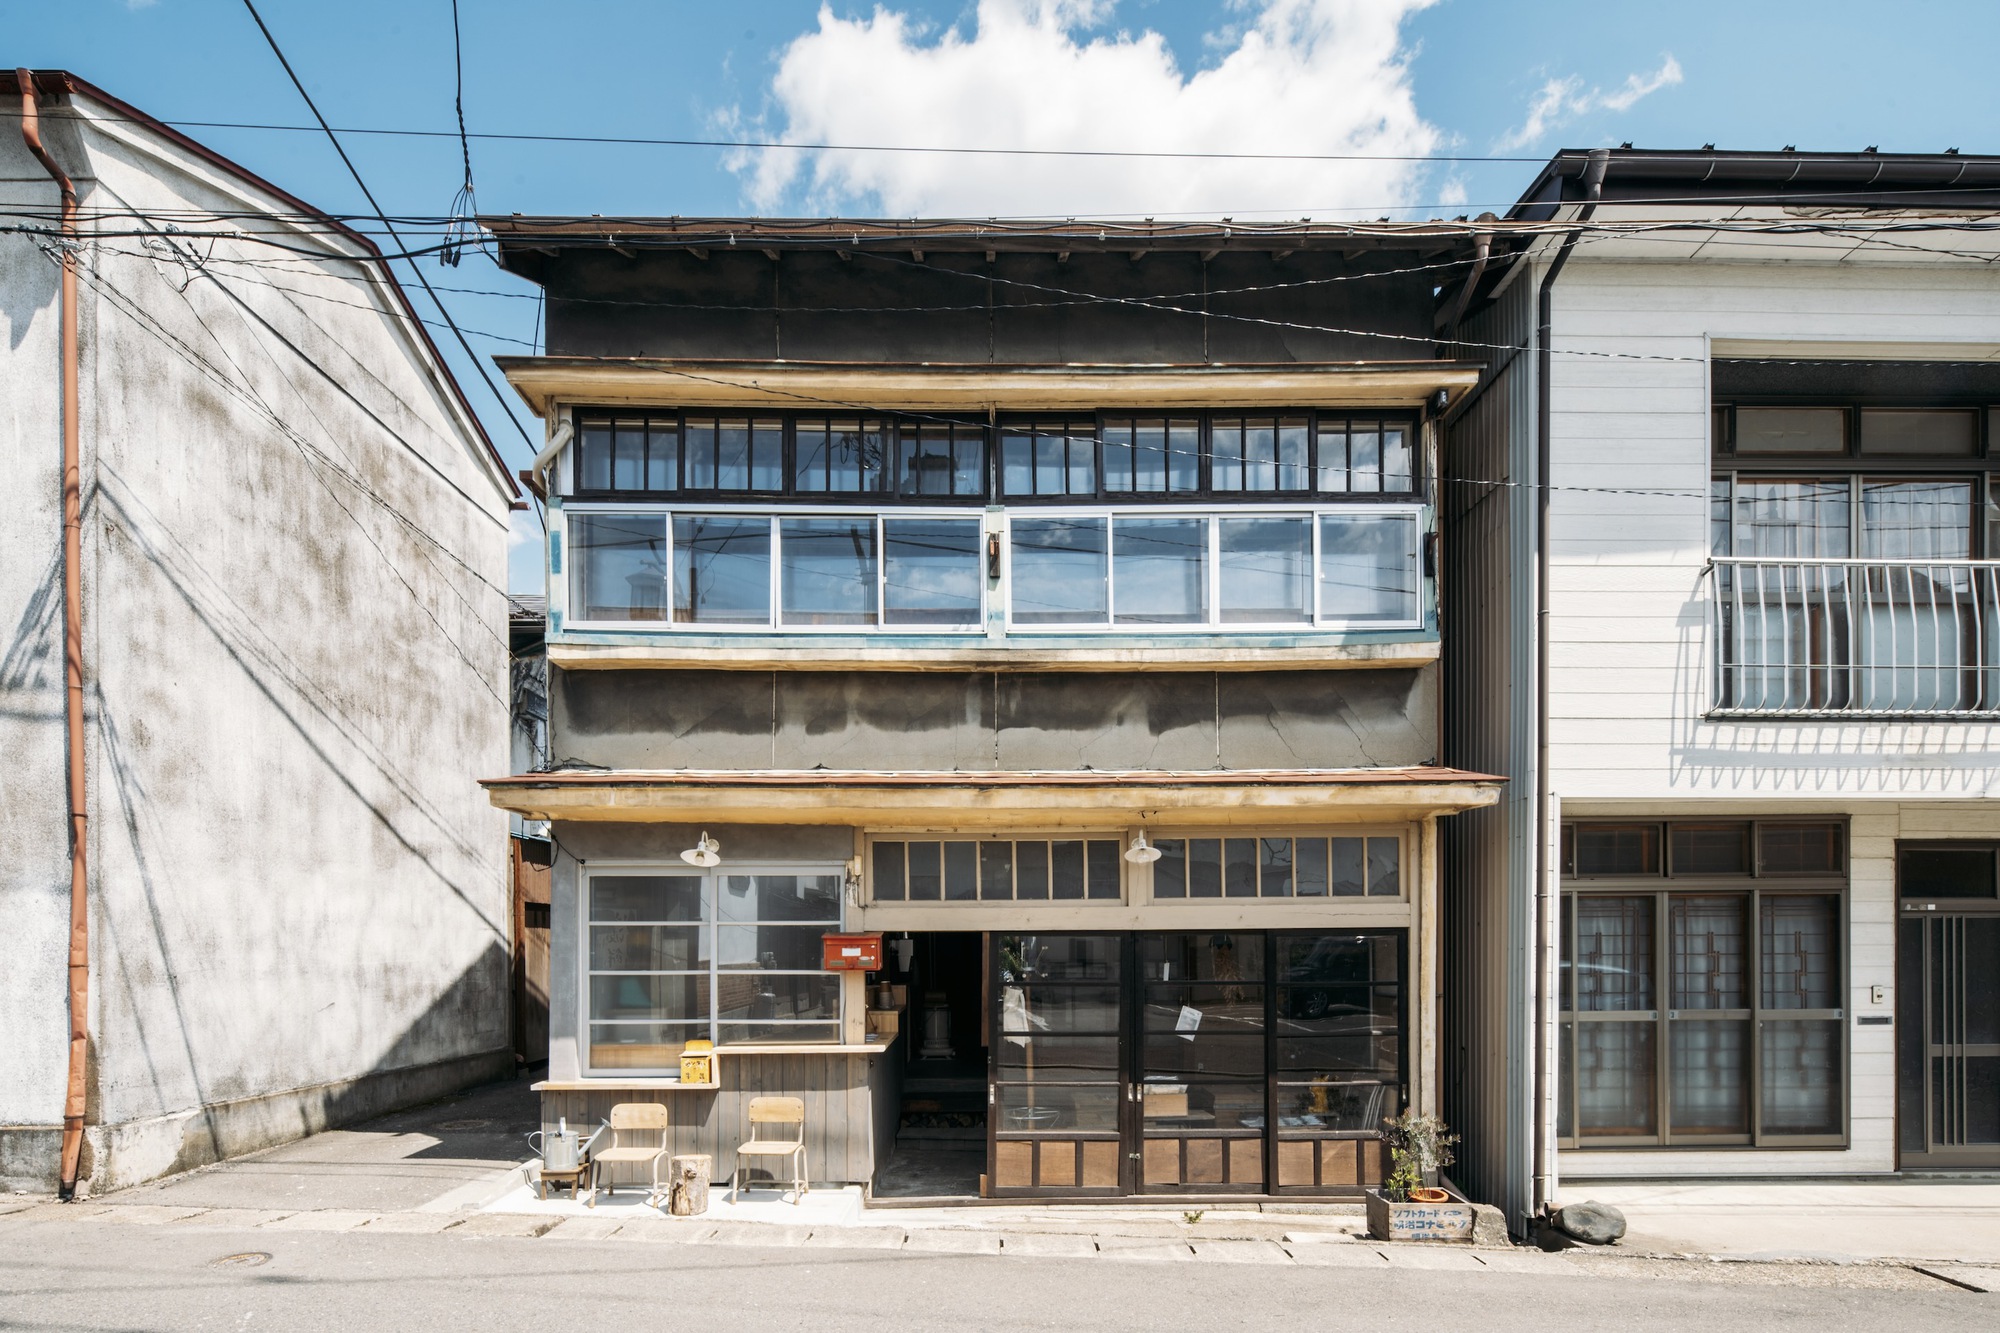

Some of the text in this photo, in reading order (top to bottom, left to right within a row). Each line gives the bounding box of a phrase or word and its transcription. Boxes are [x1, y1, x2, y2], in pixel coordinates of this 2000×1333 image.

[1394, 1209, 1440, 1218] ソフトカード
